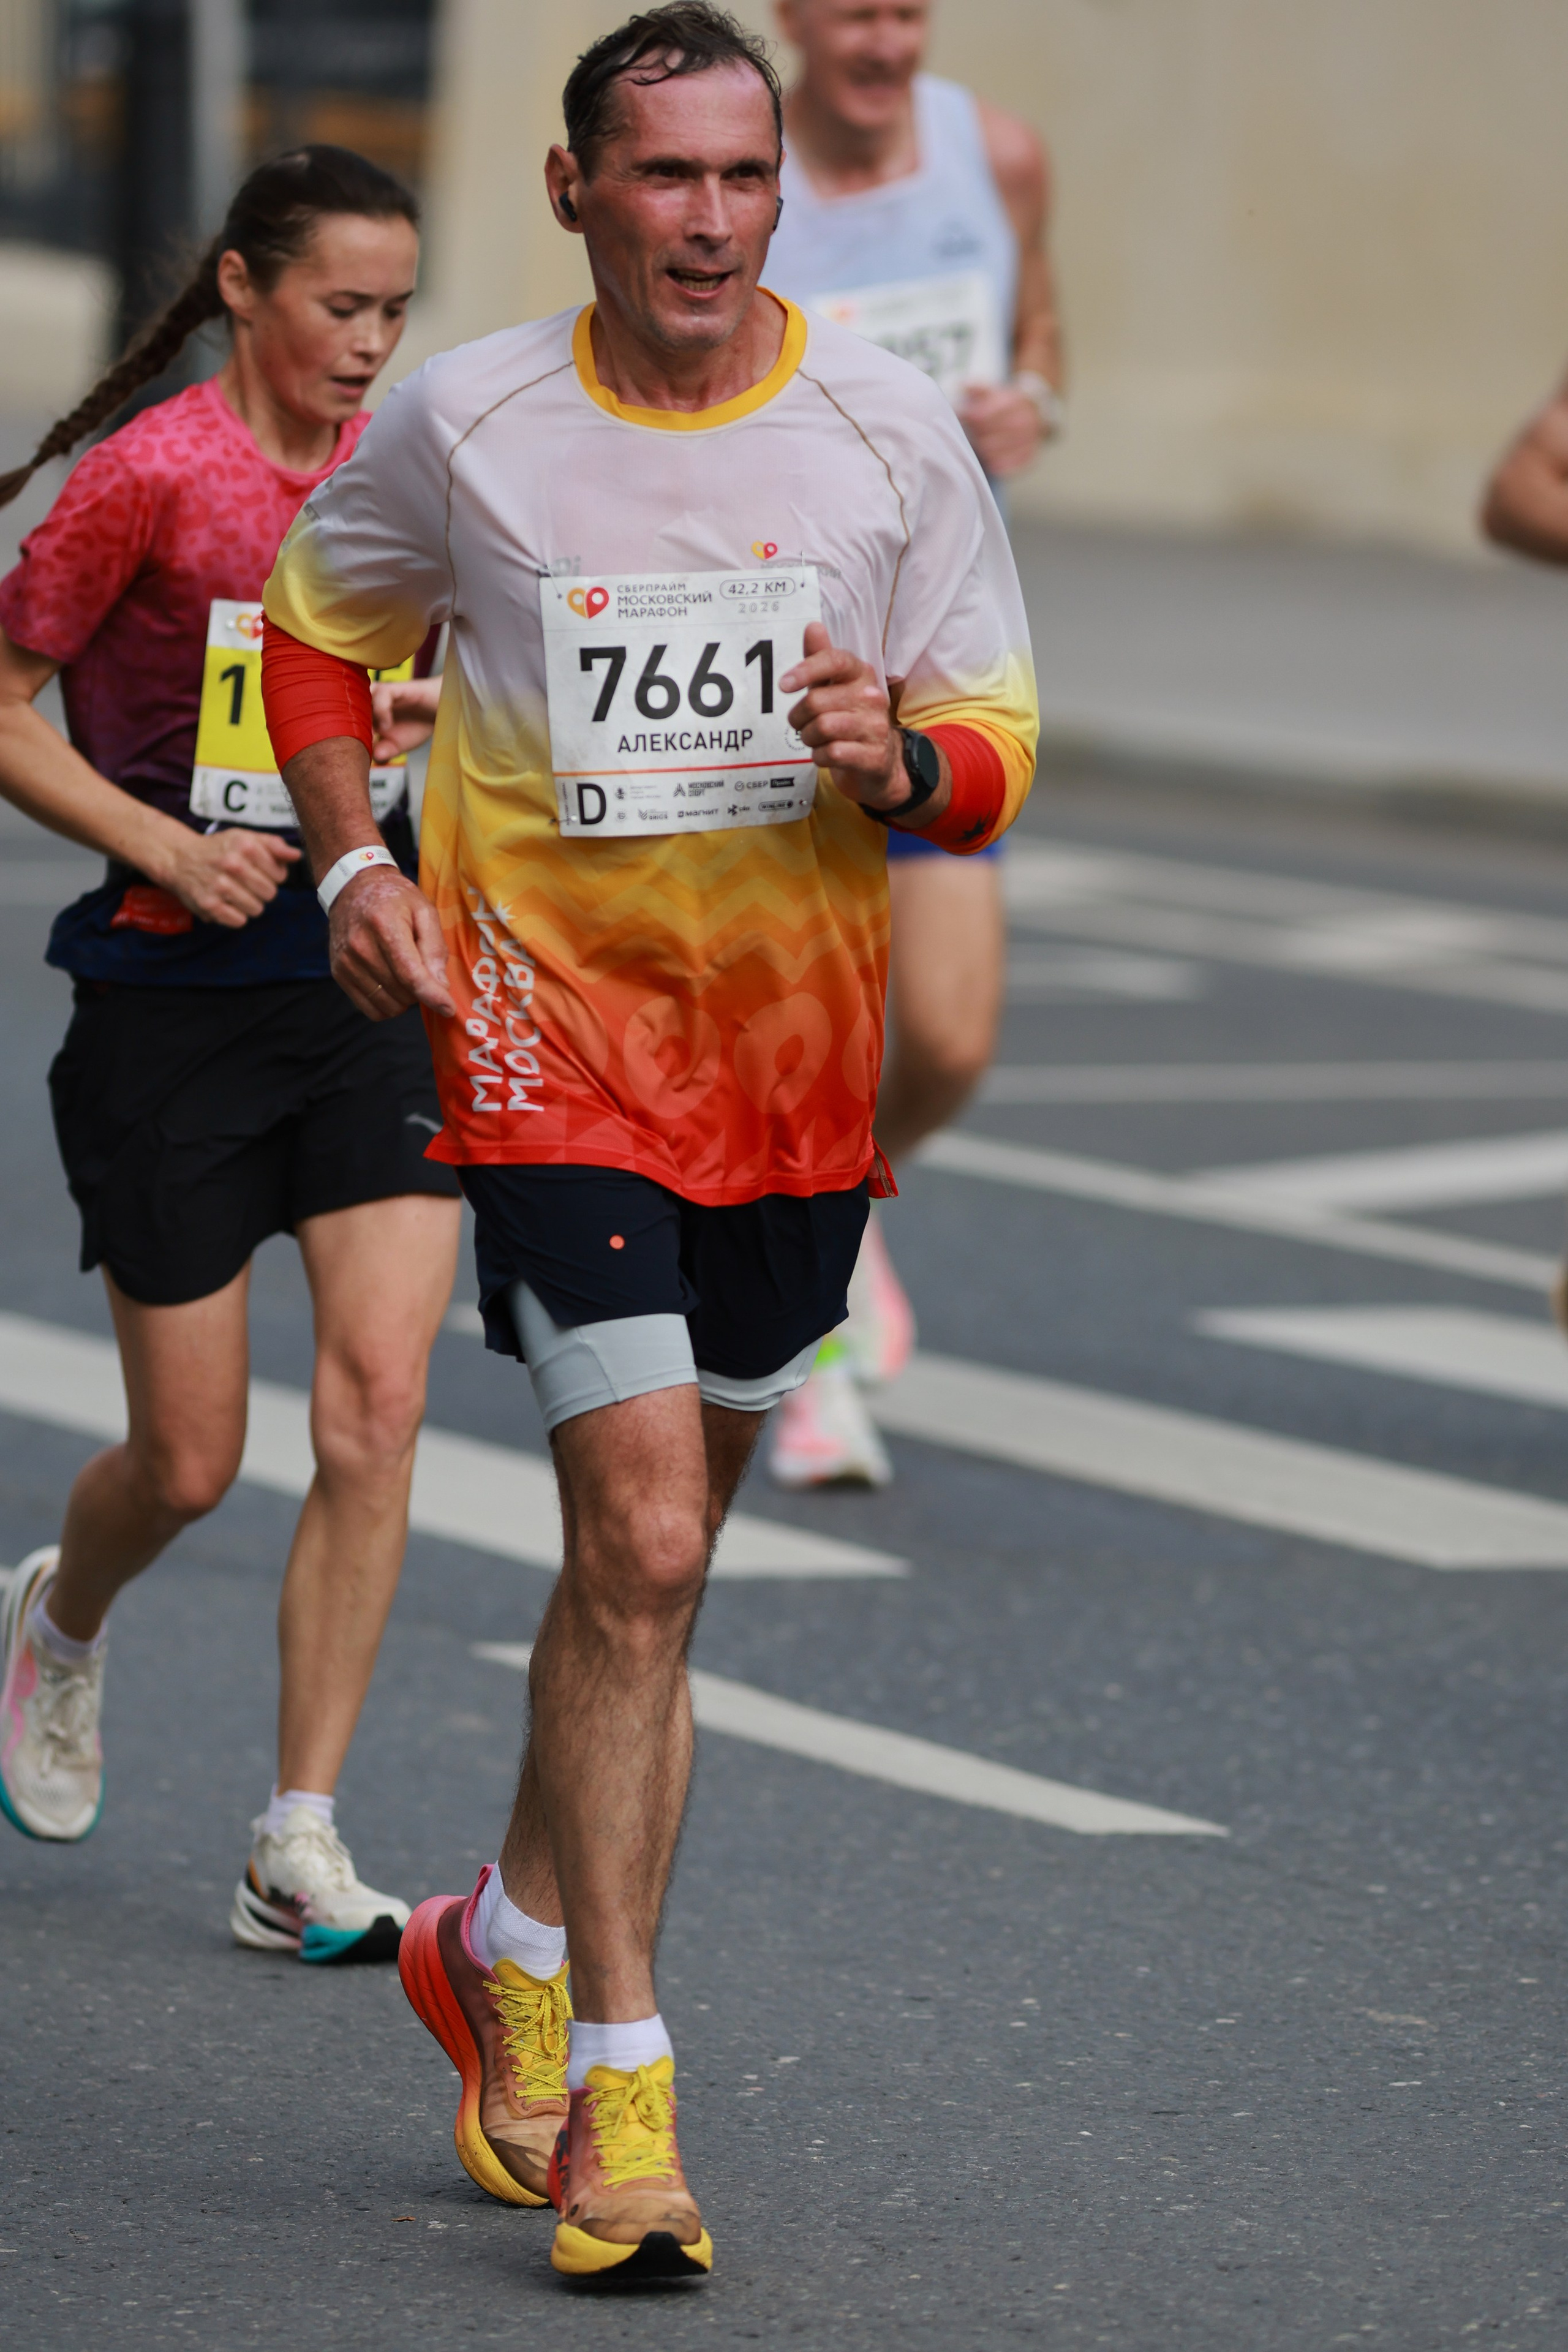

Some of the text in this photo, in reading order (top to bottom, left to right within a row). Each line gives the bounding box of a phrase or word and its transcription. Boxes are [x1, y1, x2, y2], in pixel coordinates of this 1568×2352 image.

[617, 582, 686, 594] СБЕРПРАЙМ
[728, 582, 758, 595] 42,2
[617, 591, 712, 606] МОСКОВСКИЙ
[618, 606, 687, 619] МАРАФОН
[738, 601, 780, 613] 2026
[579, 639, 774, 723] 7661
[617, 729, 753, 753] АЛЕКСАНДР
[577, 783, 606, 825] D
[499, 938, 545, 1112] МОСКВА
